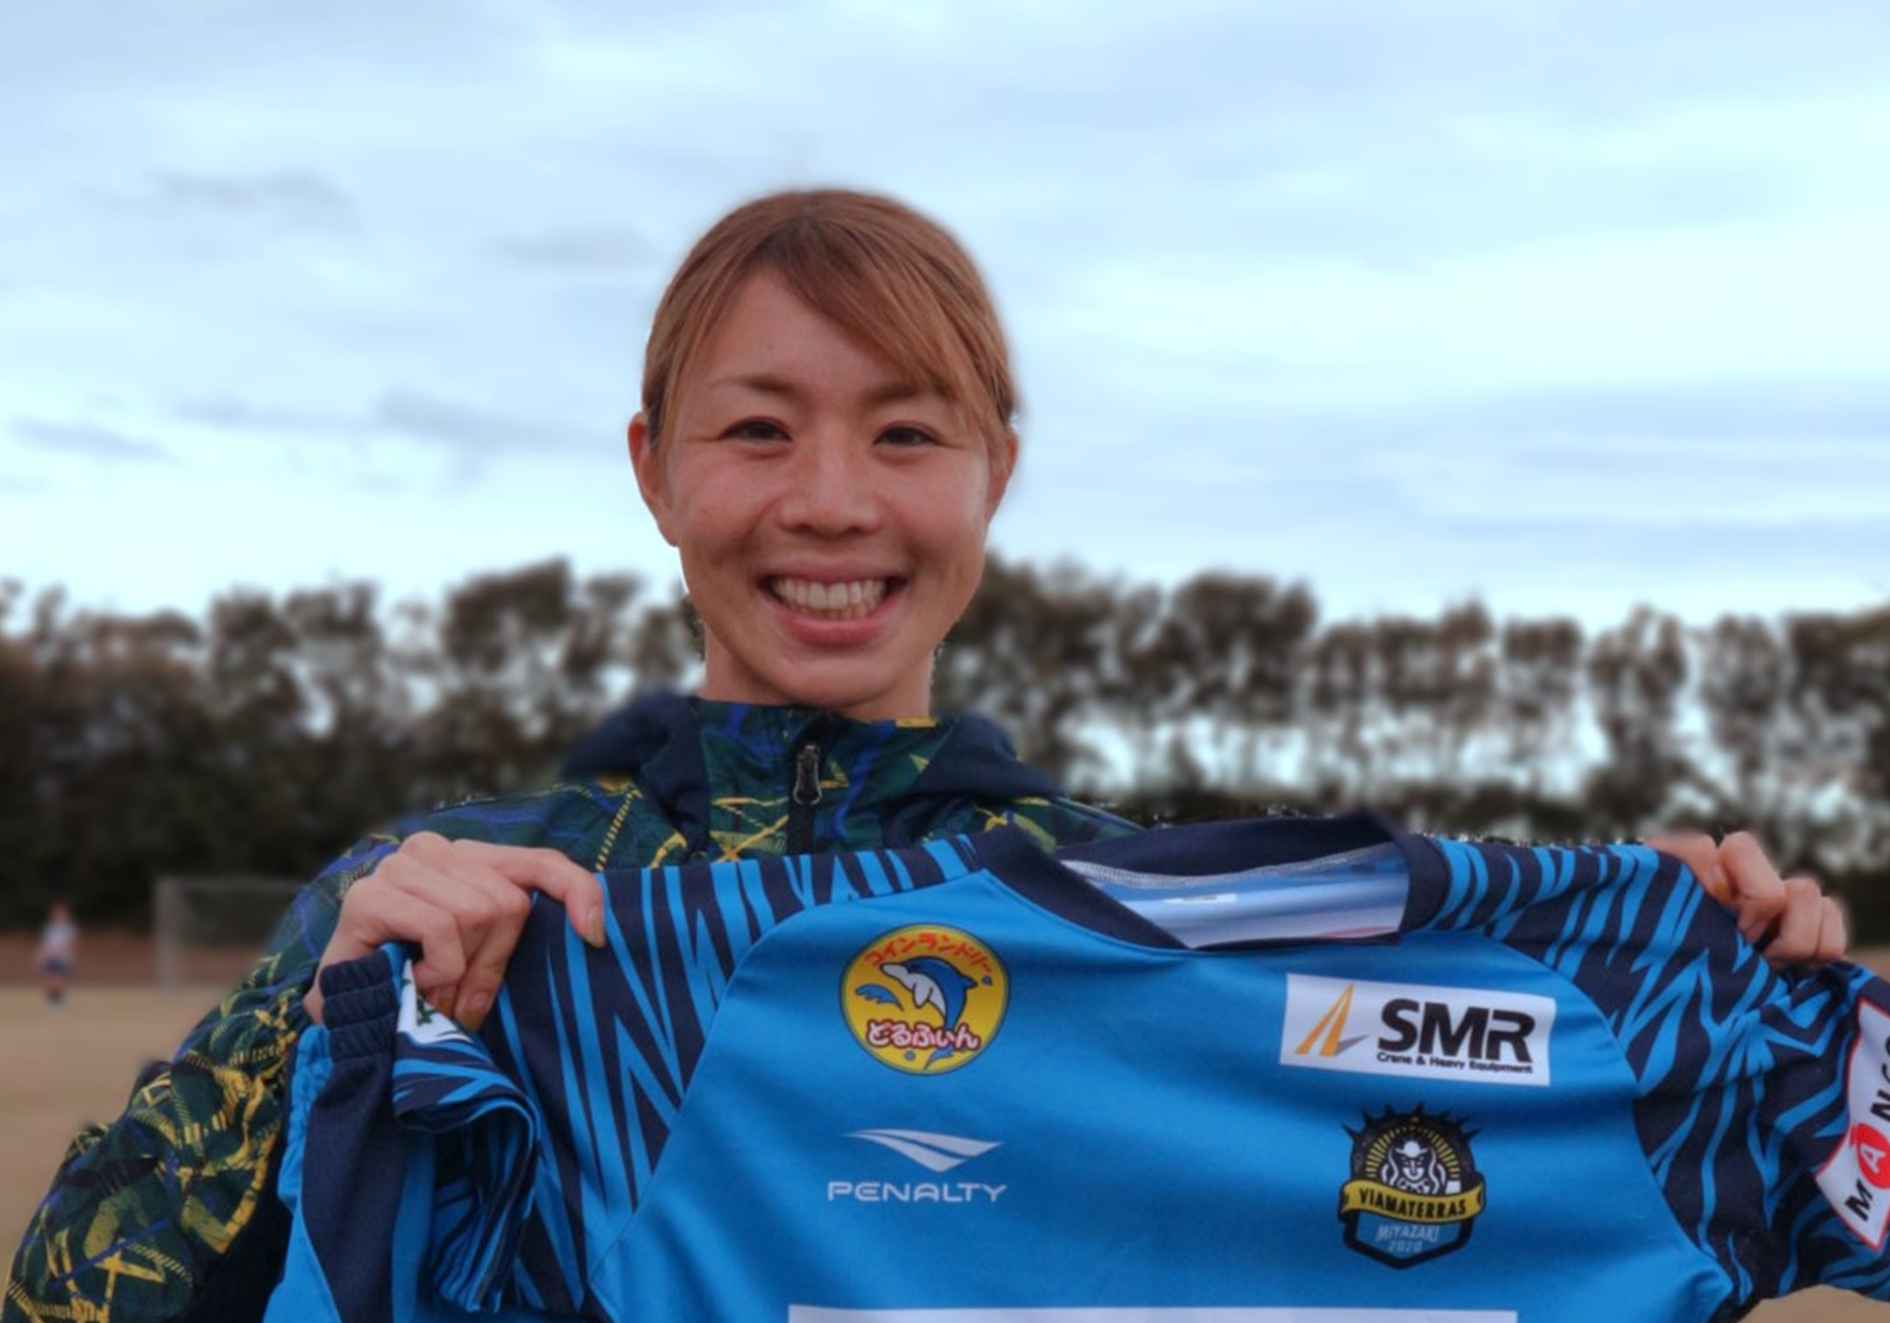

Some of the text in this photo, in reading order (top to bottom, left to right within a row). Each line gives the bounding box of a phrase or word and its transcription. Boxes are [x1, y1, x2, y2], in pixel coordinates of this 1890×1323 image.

[1378, 998, 1536, 1063] SMR
[1376, 1051, 1534, 1075] Crane & Heavy Equipment
[827, 1180, 1007, 1203] PENALTY
[1358, 1187, 1467, 1219] VIAMATERRAS
